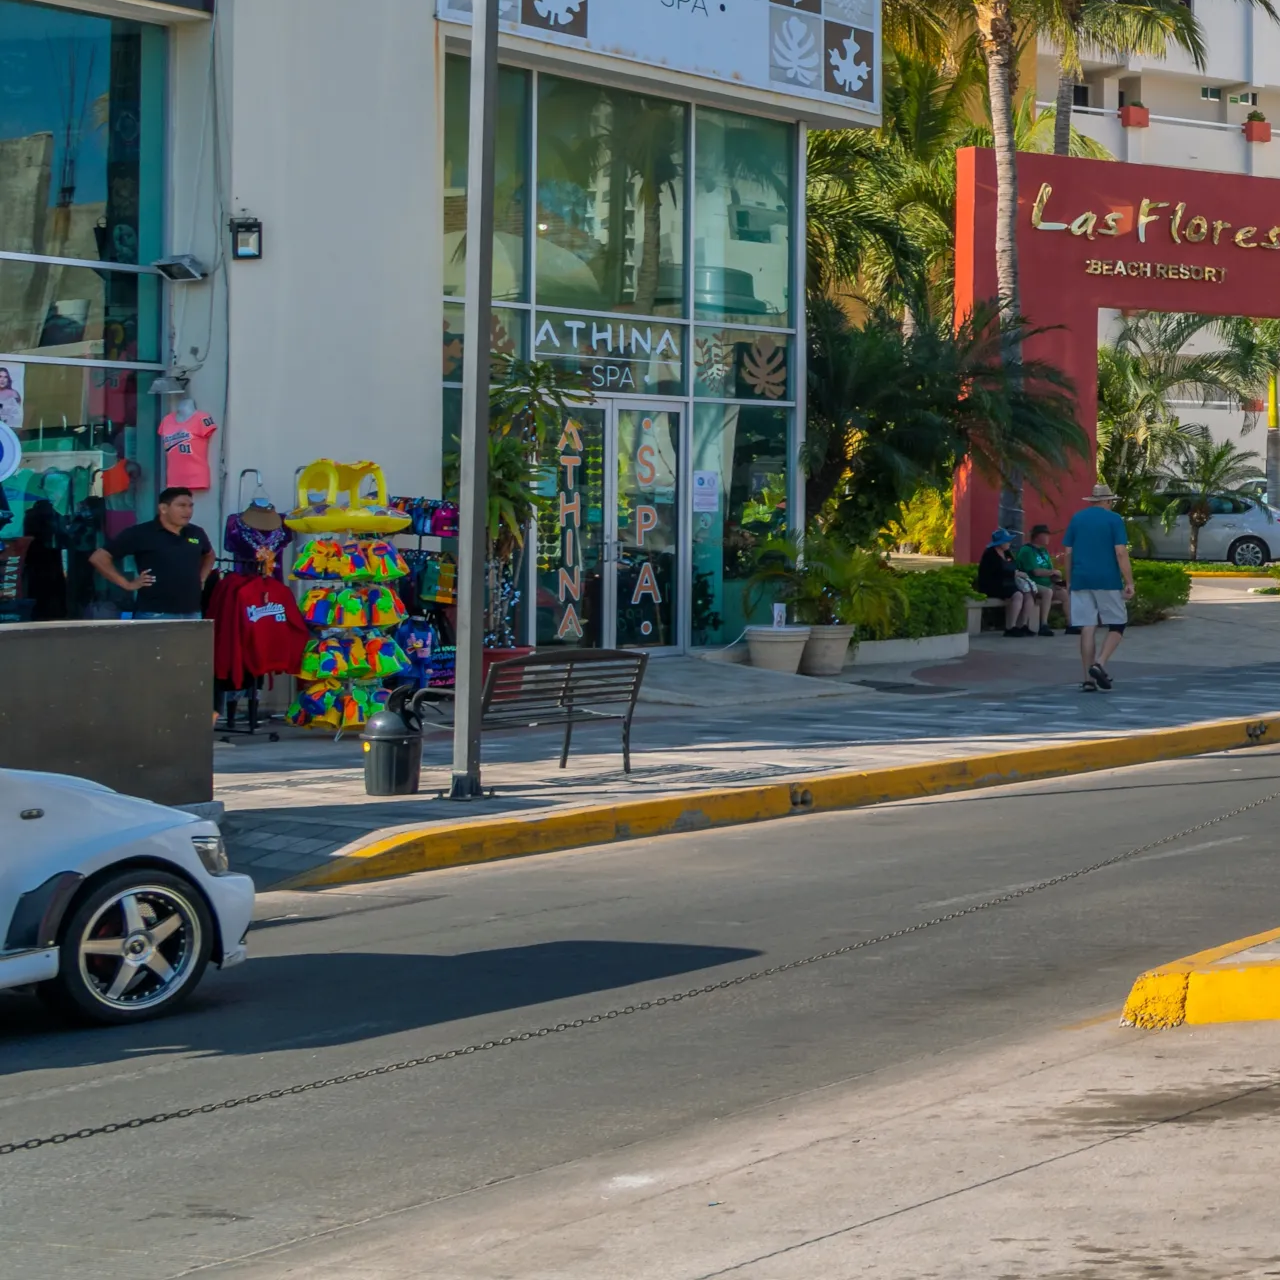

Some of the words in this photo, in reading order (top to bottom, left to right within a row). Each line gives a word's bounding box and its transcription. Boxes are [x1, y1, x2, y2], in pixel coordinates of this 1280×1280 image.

[1031, 182, 1124, 241] Las
[1085, 259, 1152, 279] BEACH
[1155, 263, 1228, 284] RESORT
[534, 319, 679, 357] ATHINA
[591, 365, 636, 388] SPA
[557, 418, 584, 639] ATHINA
[631, 443, 663, 605] SPA
